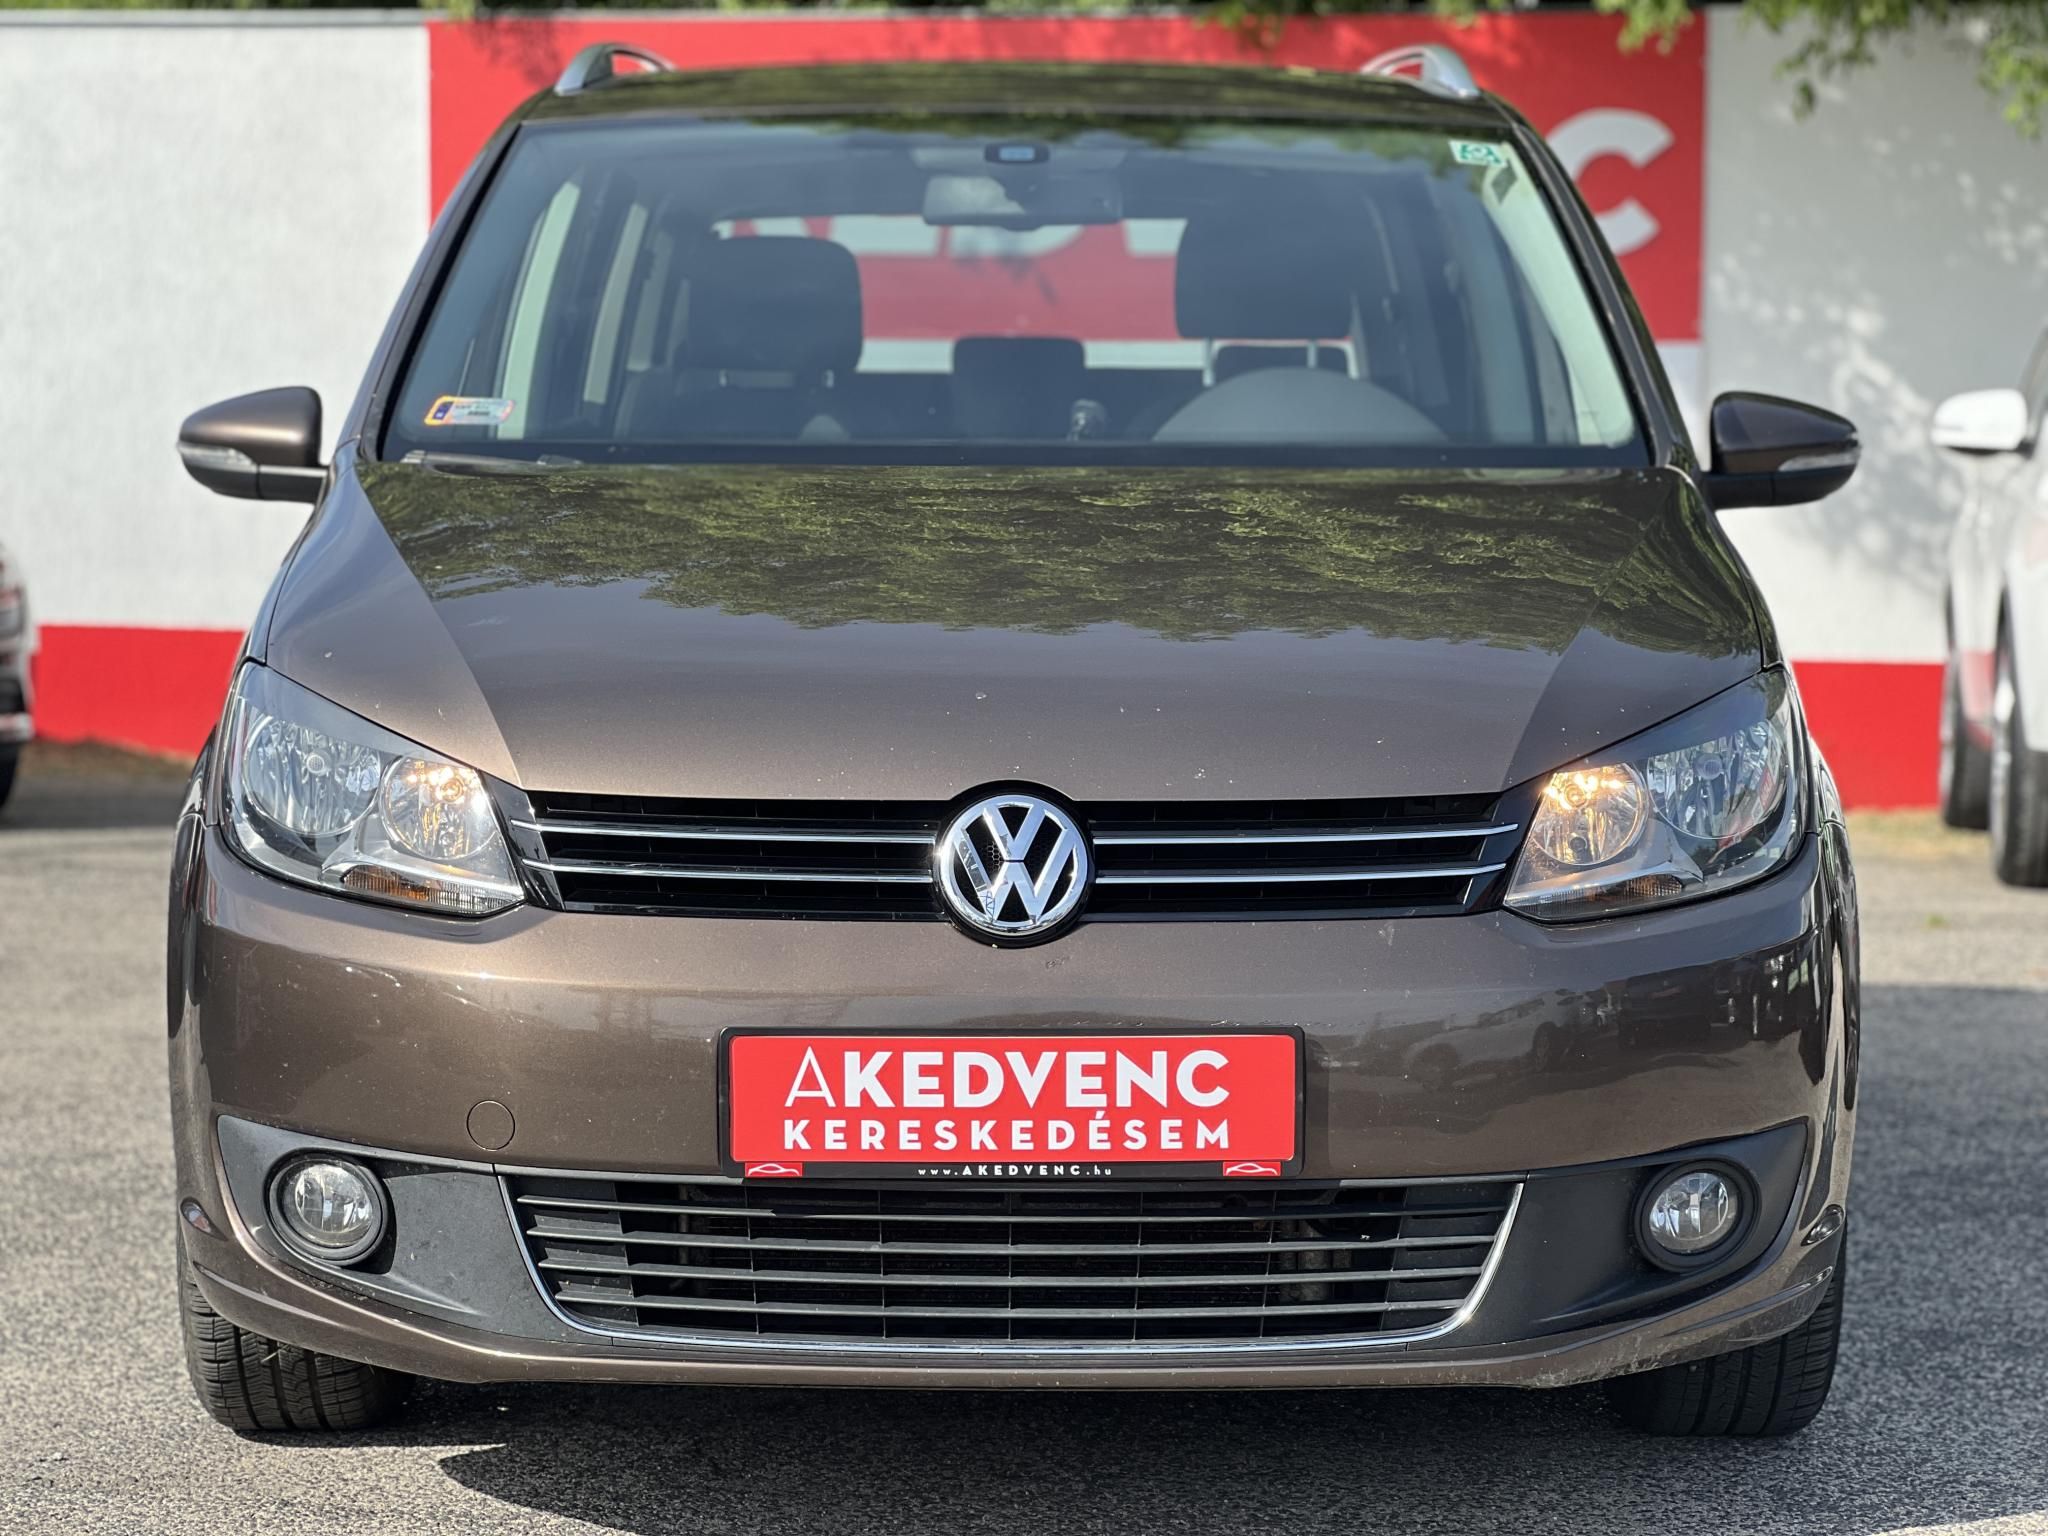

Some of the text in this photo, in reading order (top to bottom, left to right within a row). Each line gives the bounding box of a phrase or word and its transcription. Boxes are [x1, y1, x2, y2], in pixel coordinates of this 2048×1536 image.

[784, 1046, 1230, 1108] AKEDVENC
[784, 1110, 1229, 1150] KERESKEDÉSEM
[918, 1164, 1112, 1176] www.AKEDVENC.hu
